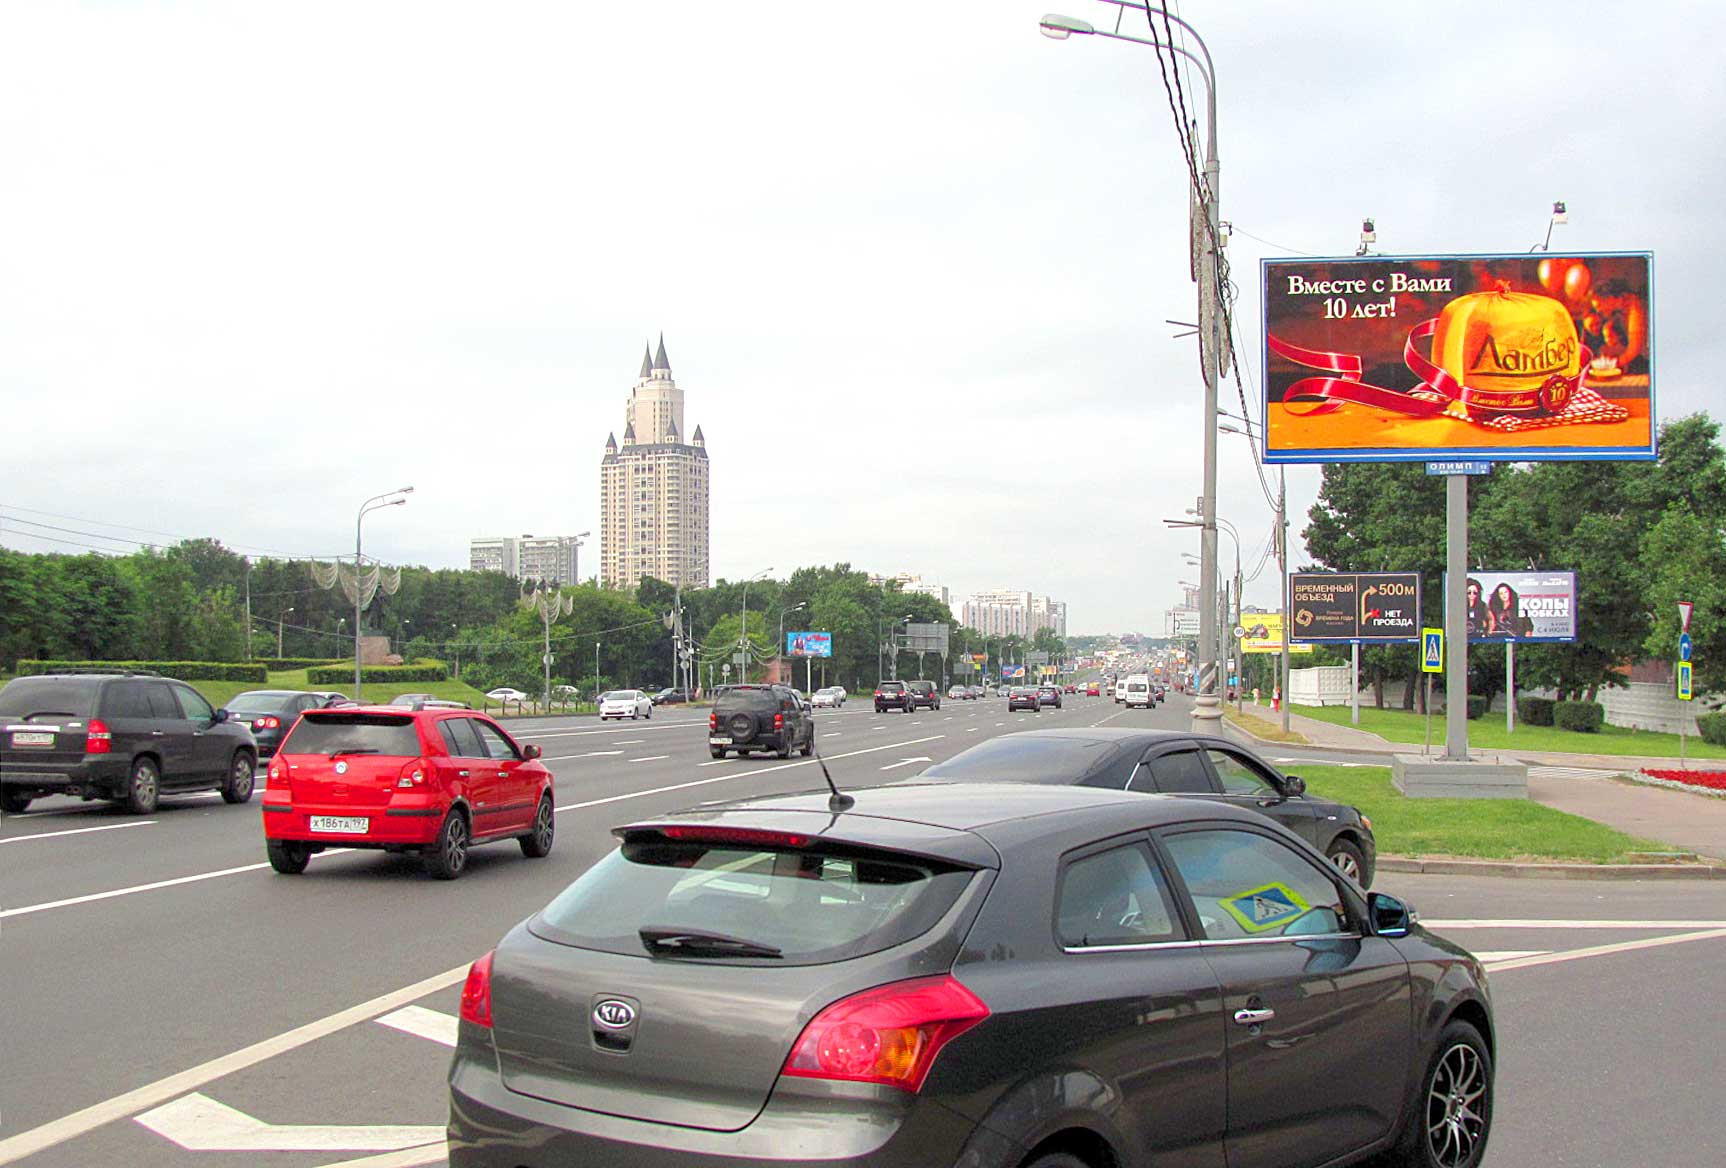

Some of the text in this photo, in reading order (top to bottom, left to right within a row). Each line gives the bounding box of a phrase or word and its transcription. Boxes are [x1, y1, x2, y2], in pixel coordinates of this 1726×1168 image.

[1287, 273, 1452, 295] Вместе с Вами
[1323, 297, 1396, 319] 10 лет!
[1550, 386, 1567, 402] 10
[1295, 583, 1354, 593] ВРЕМЕННЫЙ
[1295, 594, 1335, 602] ОБЪЕЗД
[1518, 598, 1569, 609] КОПЫ
[1384, 610, 1402, 618] НЕТ
[1527, 609, 1569, 617] ЮБКАХ
[1373, 618, 1414, 626] ПРОЕЗДА
[601, 1005, 627, 1022] KIA
